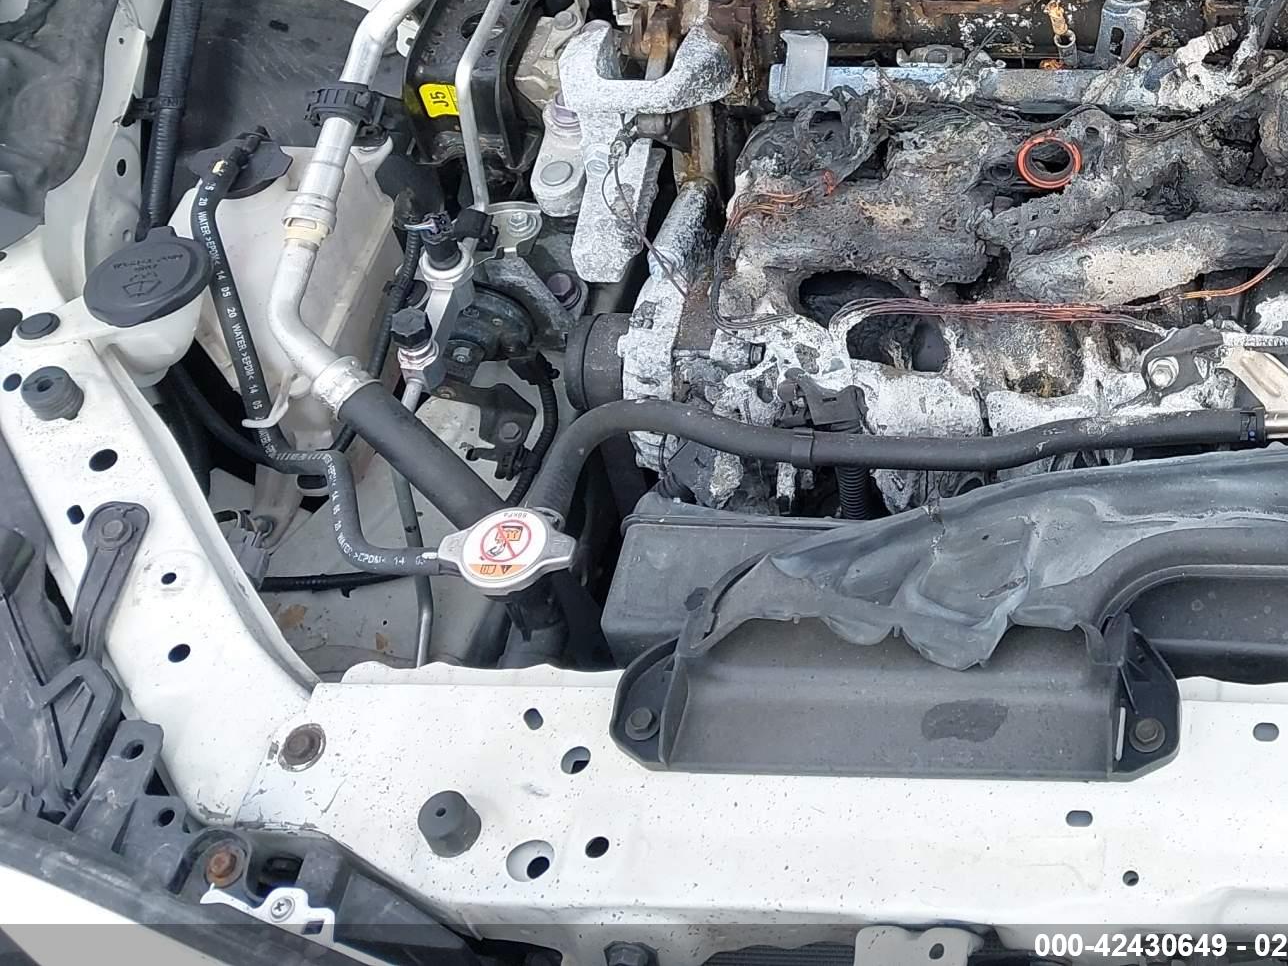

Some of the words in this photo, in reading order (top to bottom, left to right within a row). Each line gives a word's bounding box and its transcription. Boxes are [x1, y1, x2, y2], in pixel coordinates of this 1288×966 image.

[430, 92, 449, 107] J5
[198, 211, 211, 236] WATER
[227, 306, 238, 319] 20
[231, 323, 248, 352] WATER
[393, 557, 405, 566] 14
